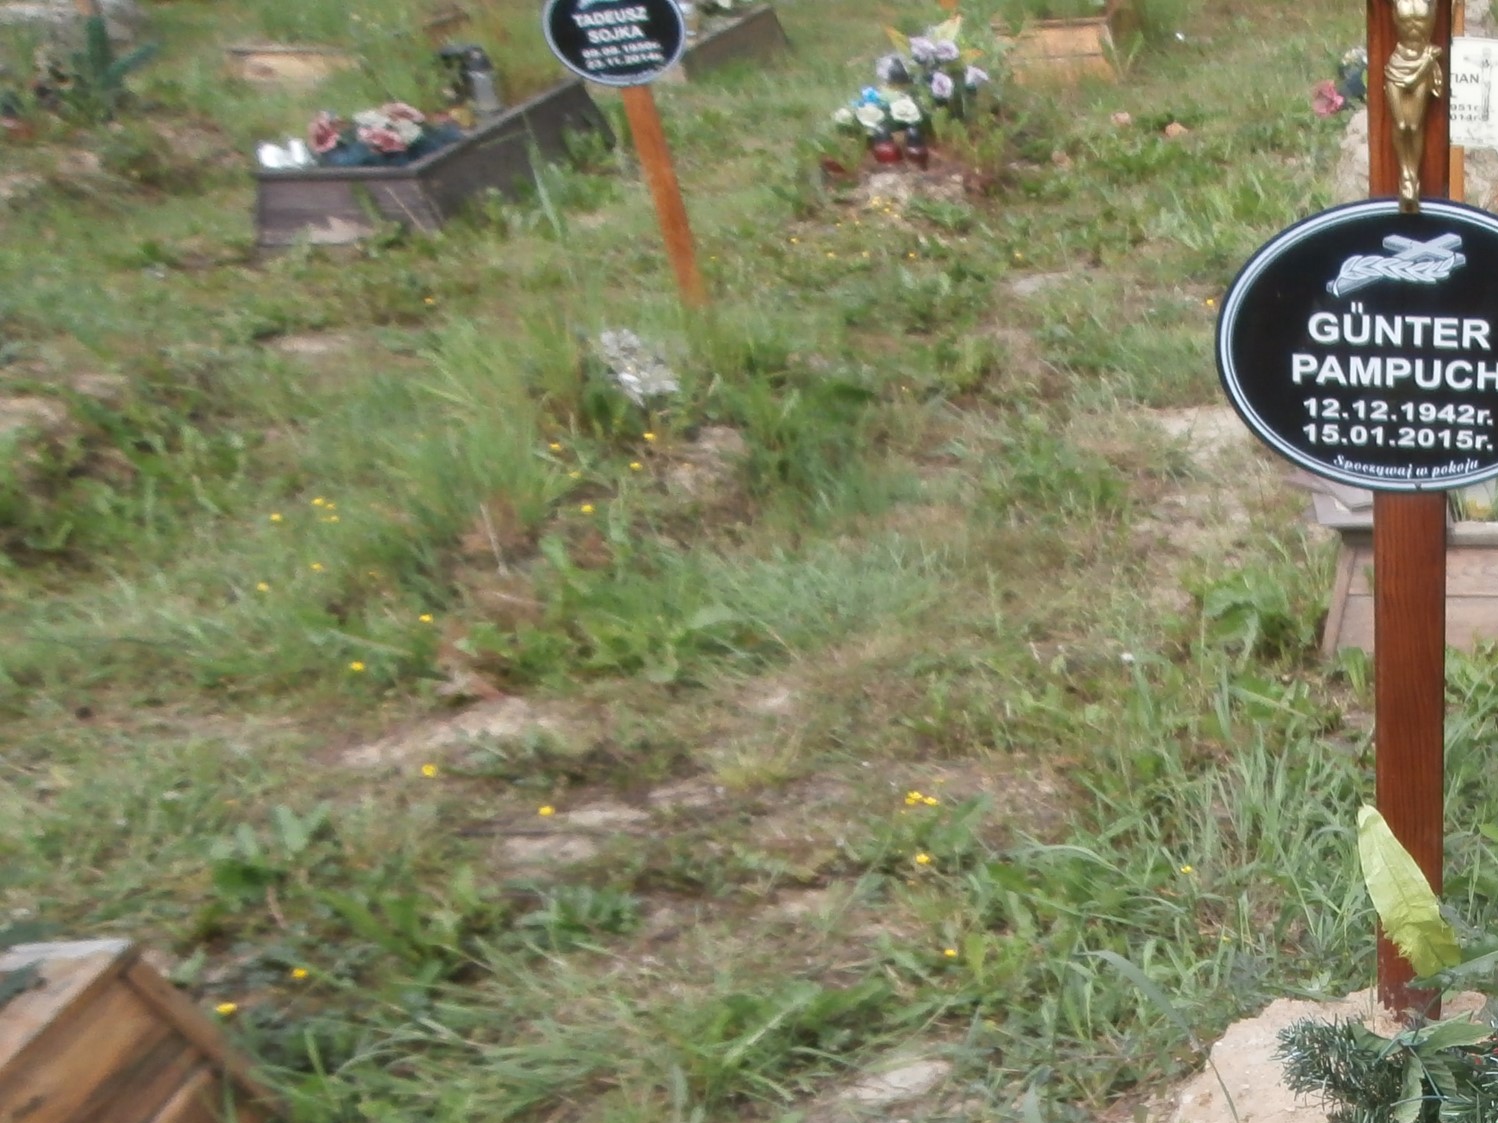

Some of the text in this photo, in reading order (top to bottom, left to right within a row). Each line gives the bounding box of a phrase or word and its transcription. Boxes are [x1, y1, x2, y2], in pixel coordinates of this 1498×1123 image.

[571, 5, 650, 28] TADEUSZ
[587, 24, 645, 44] SOJKA
[1308, 302, 1491, 350] GÜNTER
[1303, 397, 1494, 425] 12.12.1942r.
[1302, 423, 1494, 450] 15.01.2015r.
[1333, 454, 1480, 479] Spoczywaj w pokoju
